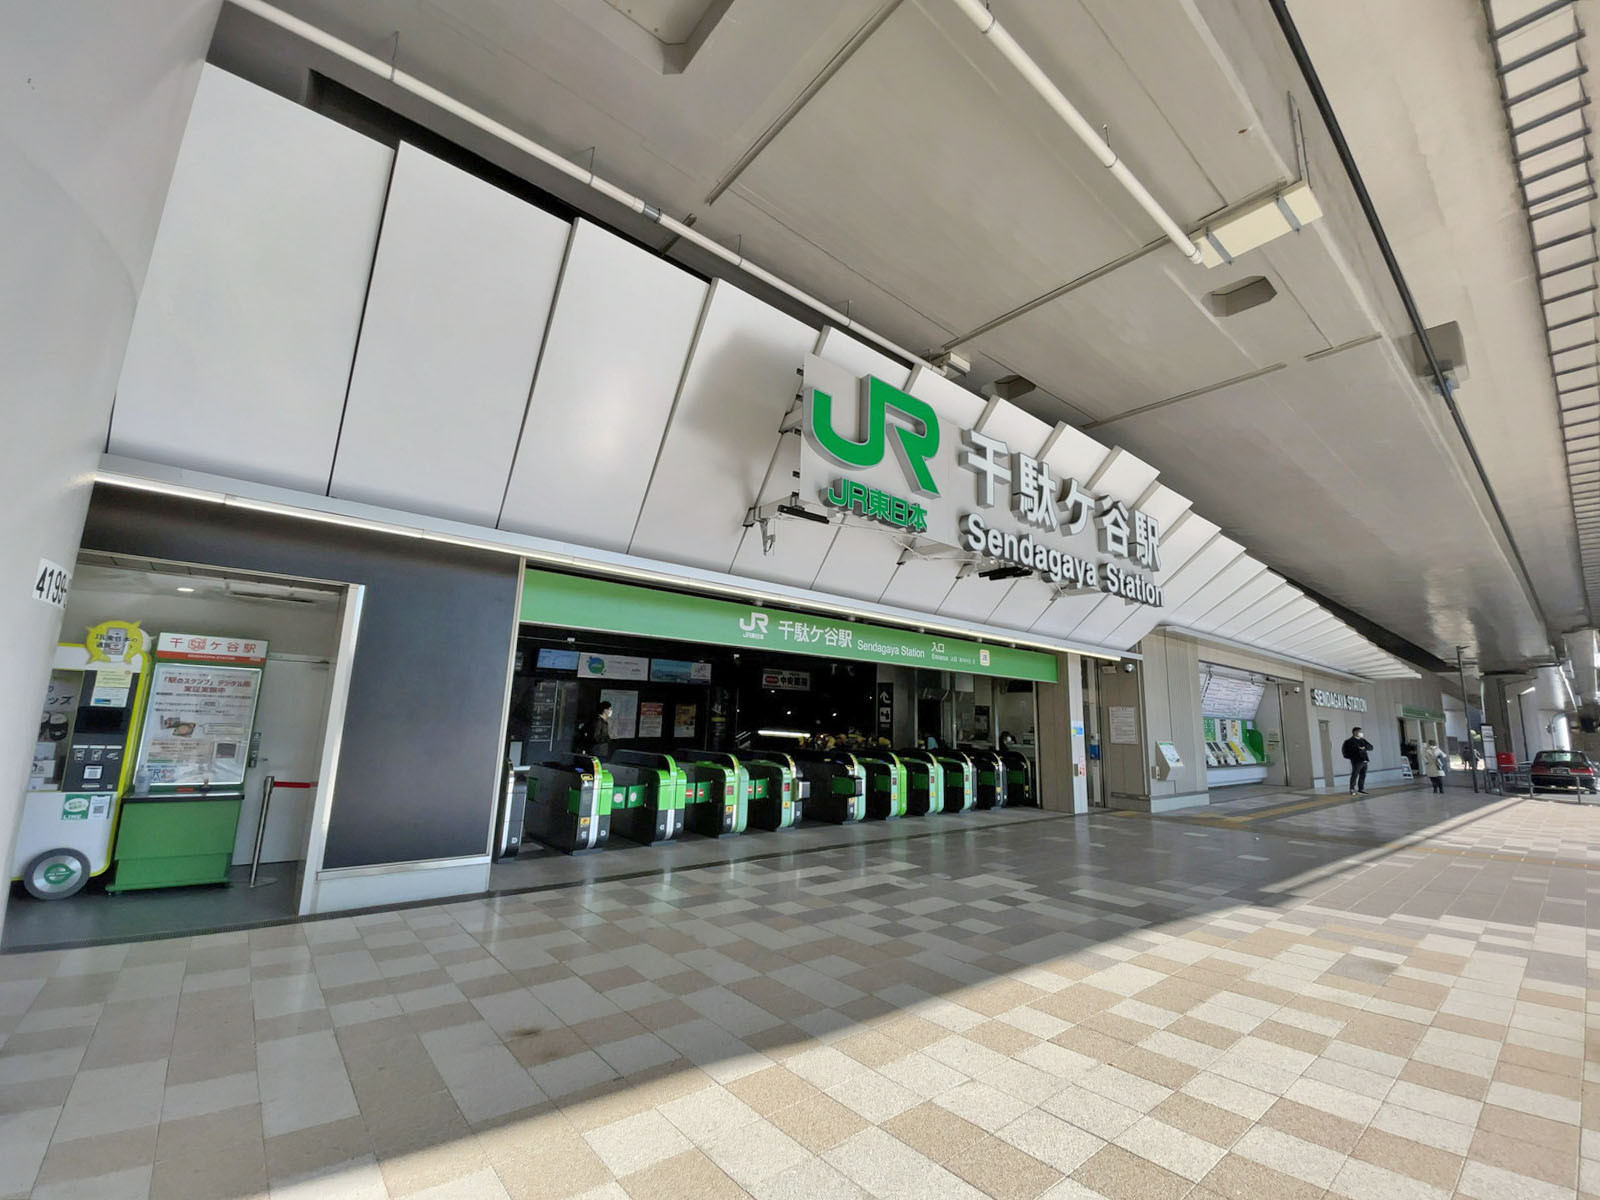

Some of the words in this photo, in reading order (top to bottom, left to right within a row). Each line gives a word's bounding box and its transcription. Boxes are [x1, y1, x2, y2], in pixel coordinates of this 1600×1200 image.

[812, 375, 940, 496] JR
[827, 477, 928, 533] JR東日本
[965, 429, 1162, 572] 千駄ケ谷駅
[967, 512, 1097, 589] Sendagaya
[1106, 562, 1165, 607] Station
[739, 612, 769, 633] JR
[778, 620, 852, 648] 千駄ケ谷駅
[857, 640, 899, 656] Sendagaya
[901, 645, 925, 658] Station
[931, 642, 945, 653] 入口
[1313, 688, 1348, 709] SENDAGAYA
[1347, 695, 1368, 712] STATION
